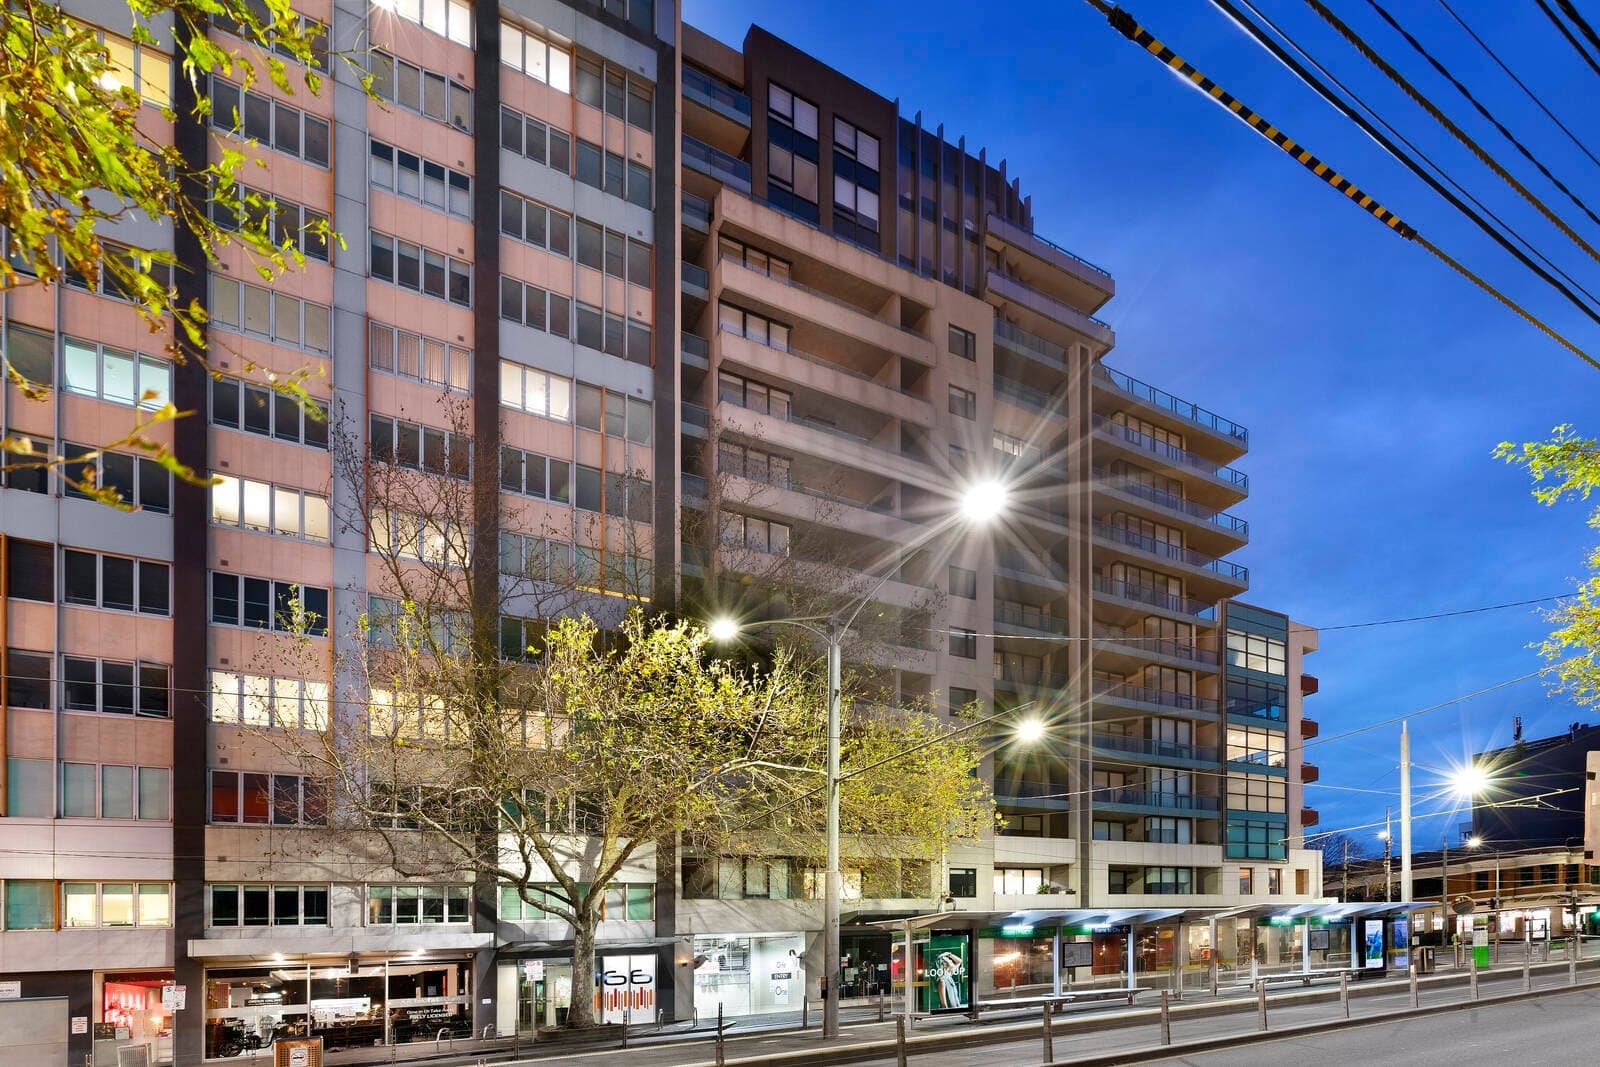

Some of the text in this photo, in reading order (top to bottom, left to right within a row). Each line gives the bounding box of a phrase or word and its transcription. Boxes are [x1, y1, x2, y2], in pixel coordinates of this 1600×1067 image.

[595, 969, 653, 987] 166
[925, 967, 966, 977] LOOK UP
